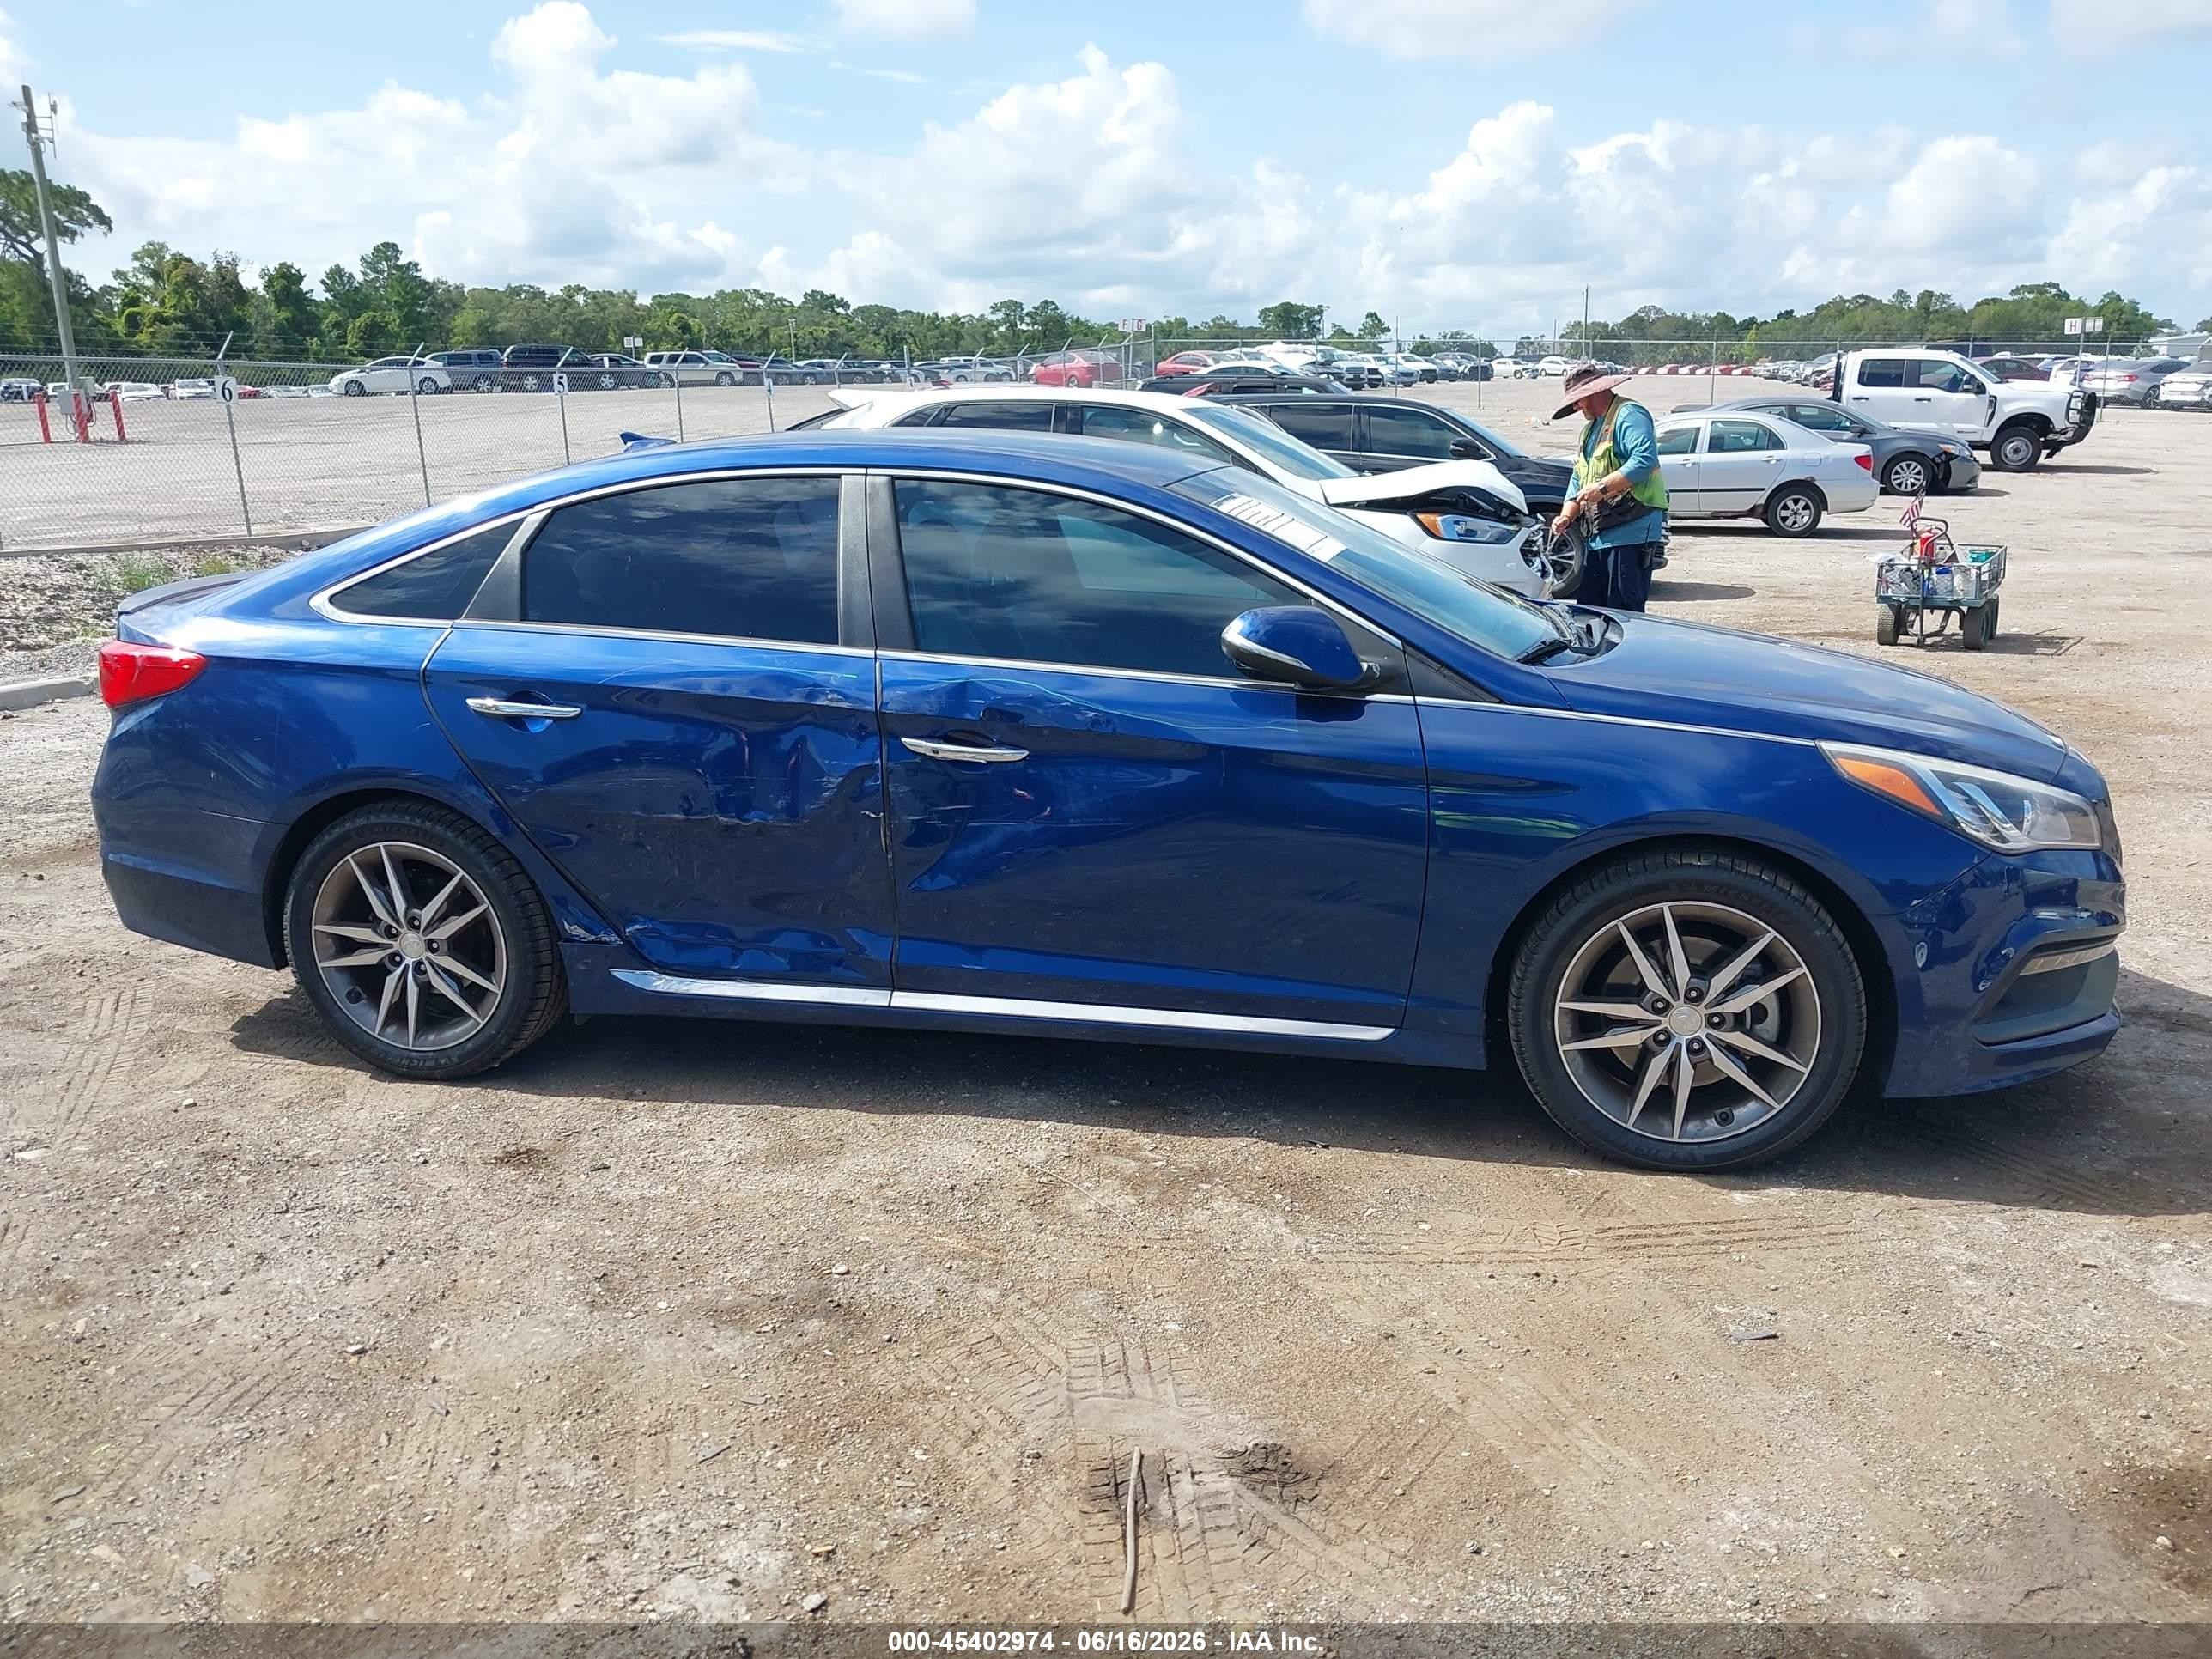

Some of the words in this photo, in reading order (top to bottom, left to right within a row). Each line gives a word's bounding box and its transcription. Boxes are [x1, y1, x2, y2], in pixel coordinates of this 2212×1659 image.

[1137, 319, 1143, 331] G
[2069, 320, 2077, 332] H
[221, 379, 233, 403] 6
[557, 375, 565, 394] 5
